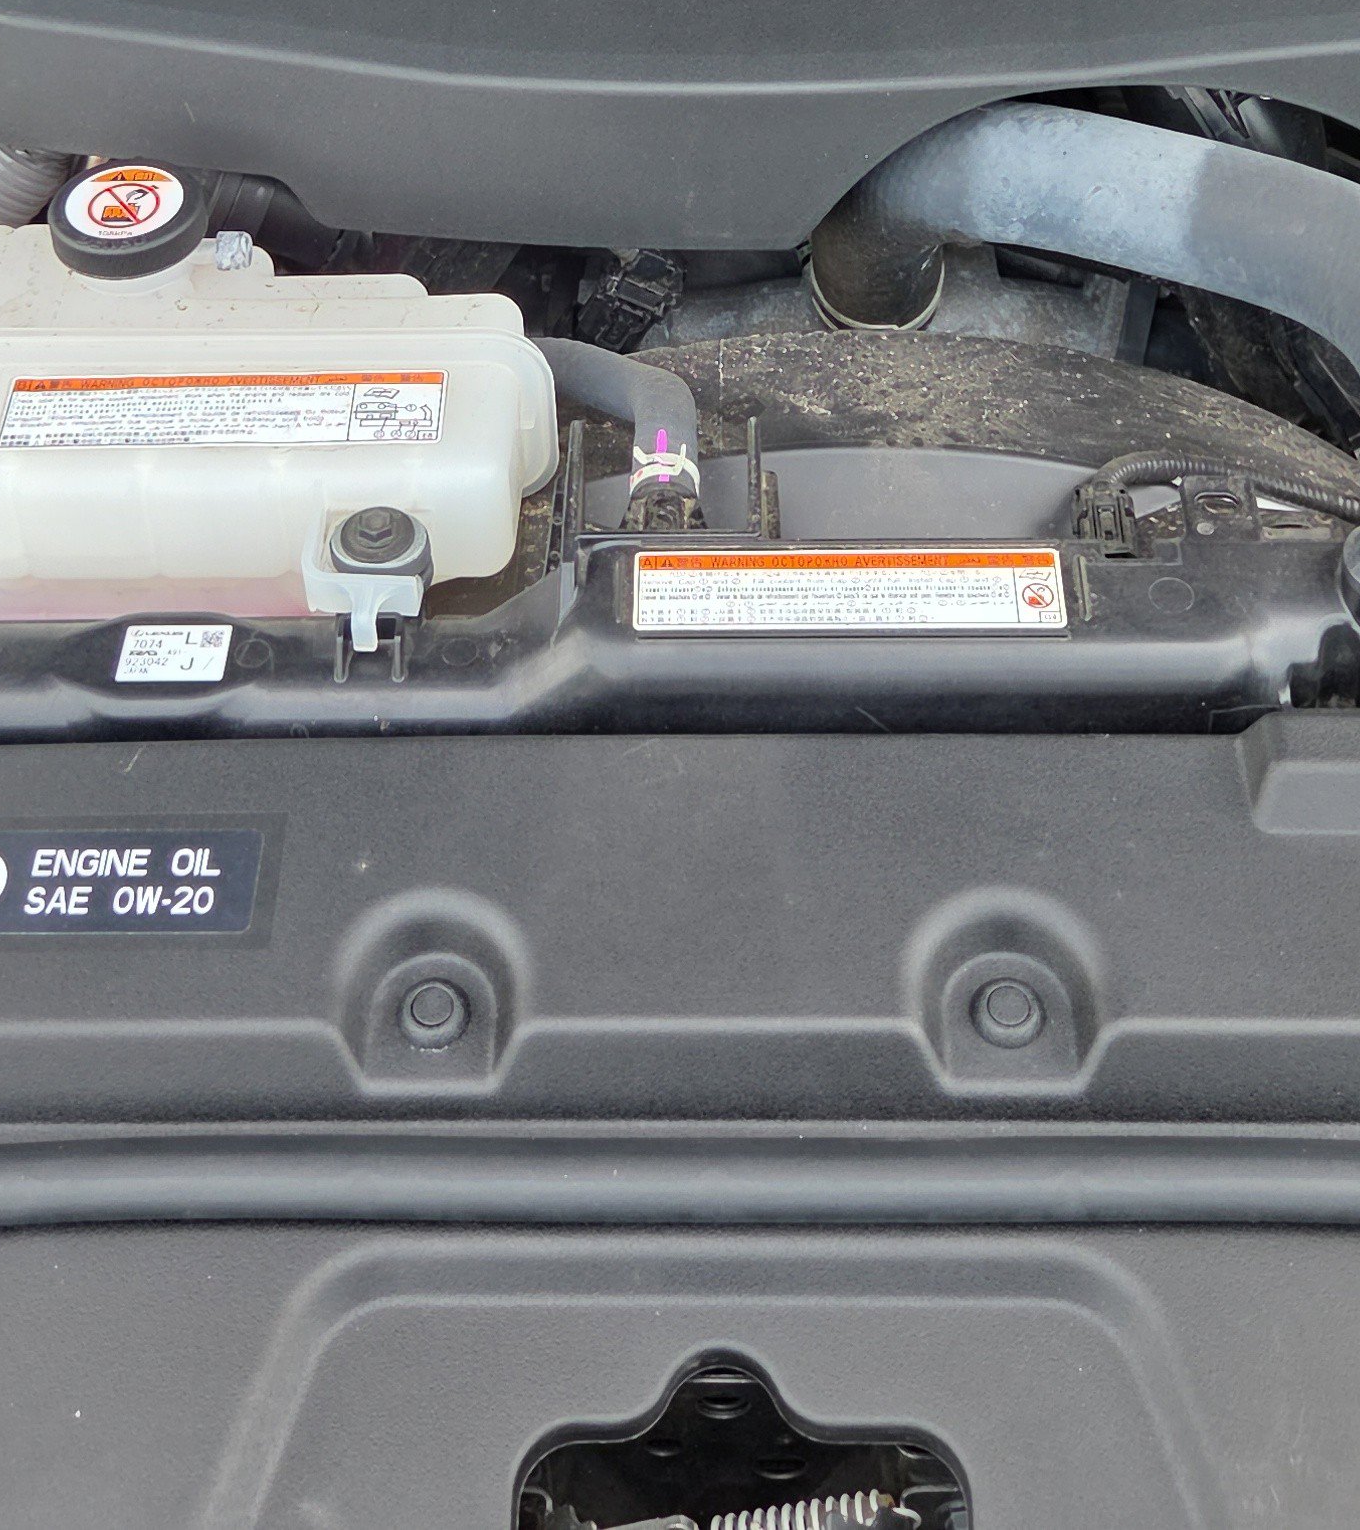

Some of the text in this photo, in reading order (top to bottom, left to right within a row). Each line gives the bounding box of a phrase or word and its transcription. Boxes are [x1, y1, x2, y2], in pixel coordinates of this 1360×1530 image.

[80, 378, 135, 389] WARNING
[226, 374, 320, 385] AVERTISSEMENT
[710, 556, 765, 568] WARNING
[854, 555, 949, 567] AVERTISSEMENT
[133, 639, 163, 648] 7074
[185, 631, 198, 645] L
[180, 656, 194, 670] J
[31, 847, 222, 877] ENGINE OIL
[23, 885, 216, 916] SAE 0W-20
